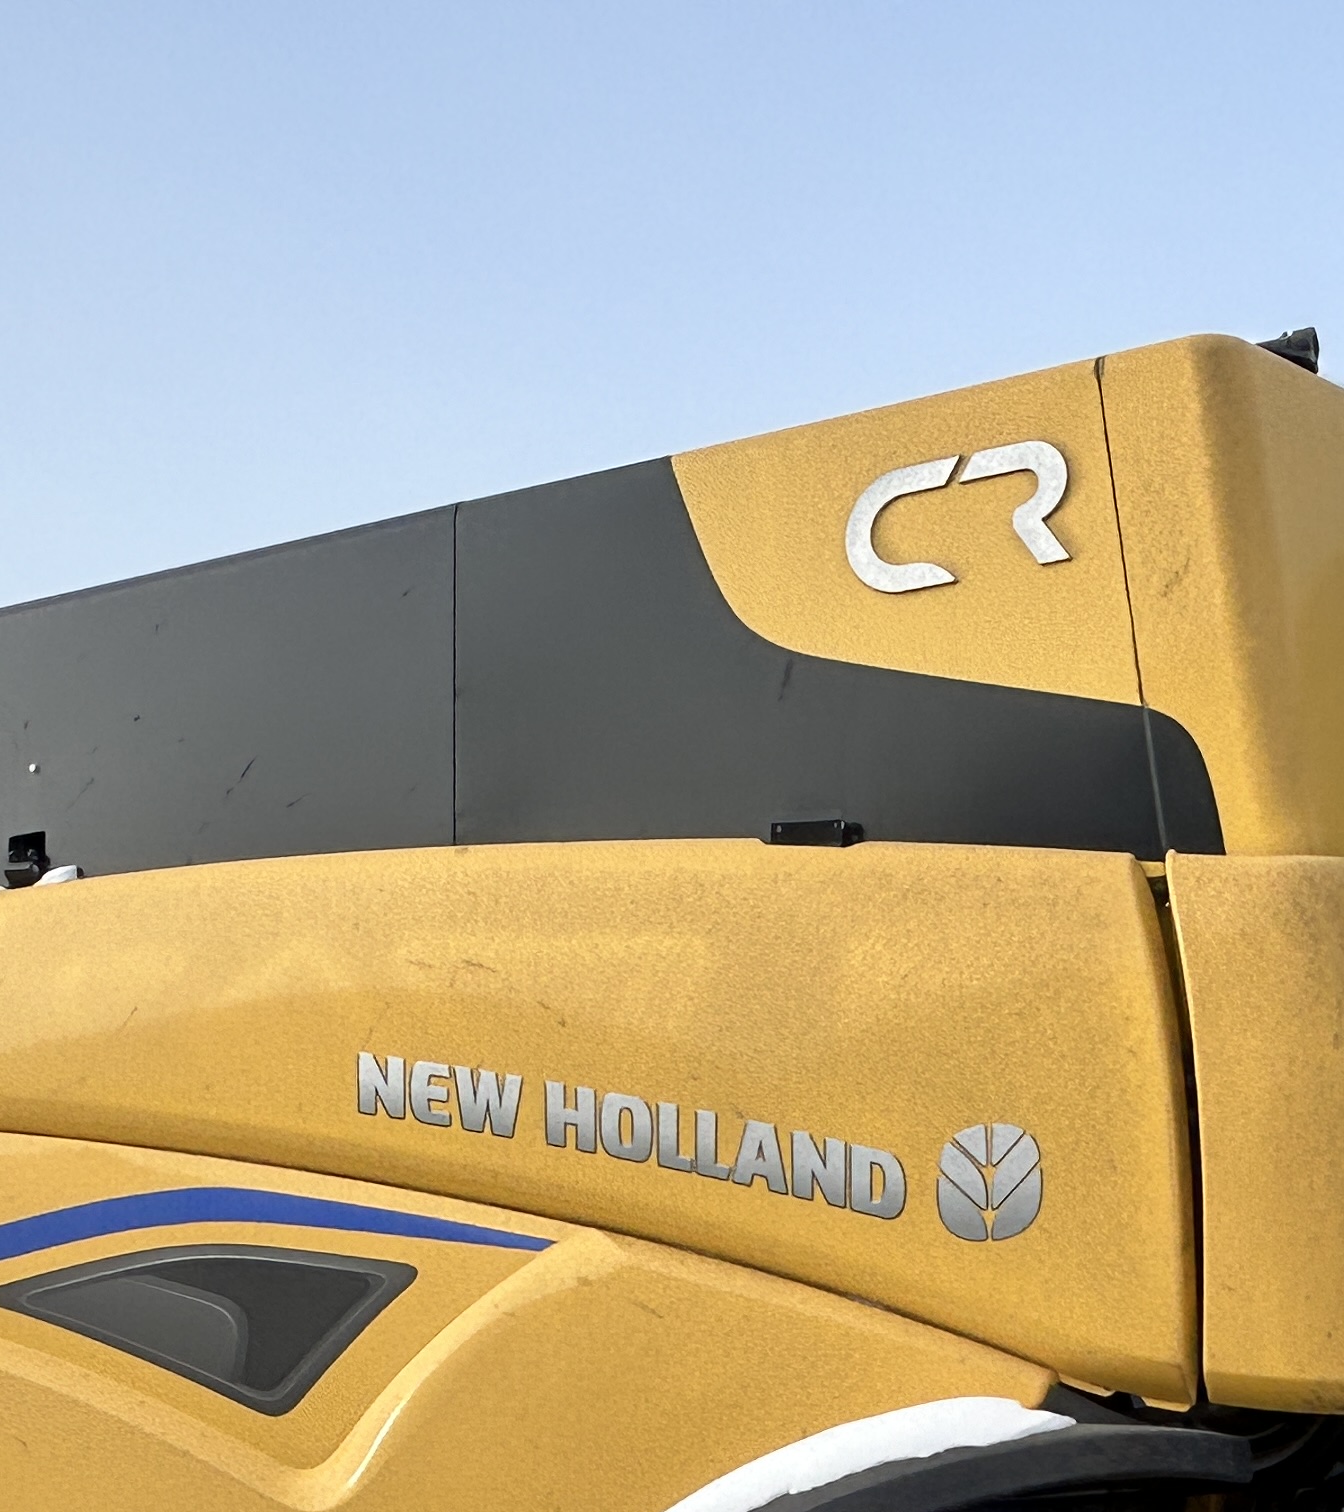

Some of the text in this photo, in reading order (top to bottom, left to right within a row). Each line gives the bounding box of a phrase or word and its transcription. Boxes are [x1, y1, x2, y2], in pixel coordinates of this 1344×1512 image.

[845, 440, 1072, 593] CR
[356, 1051, 906, 1220] NEW HOLLAND
